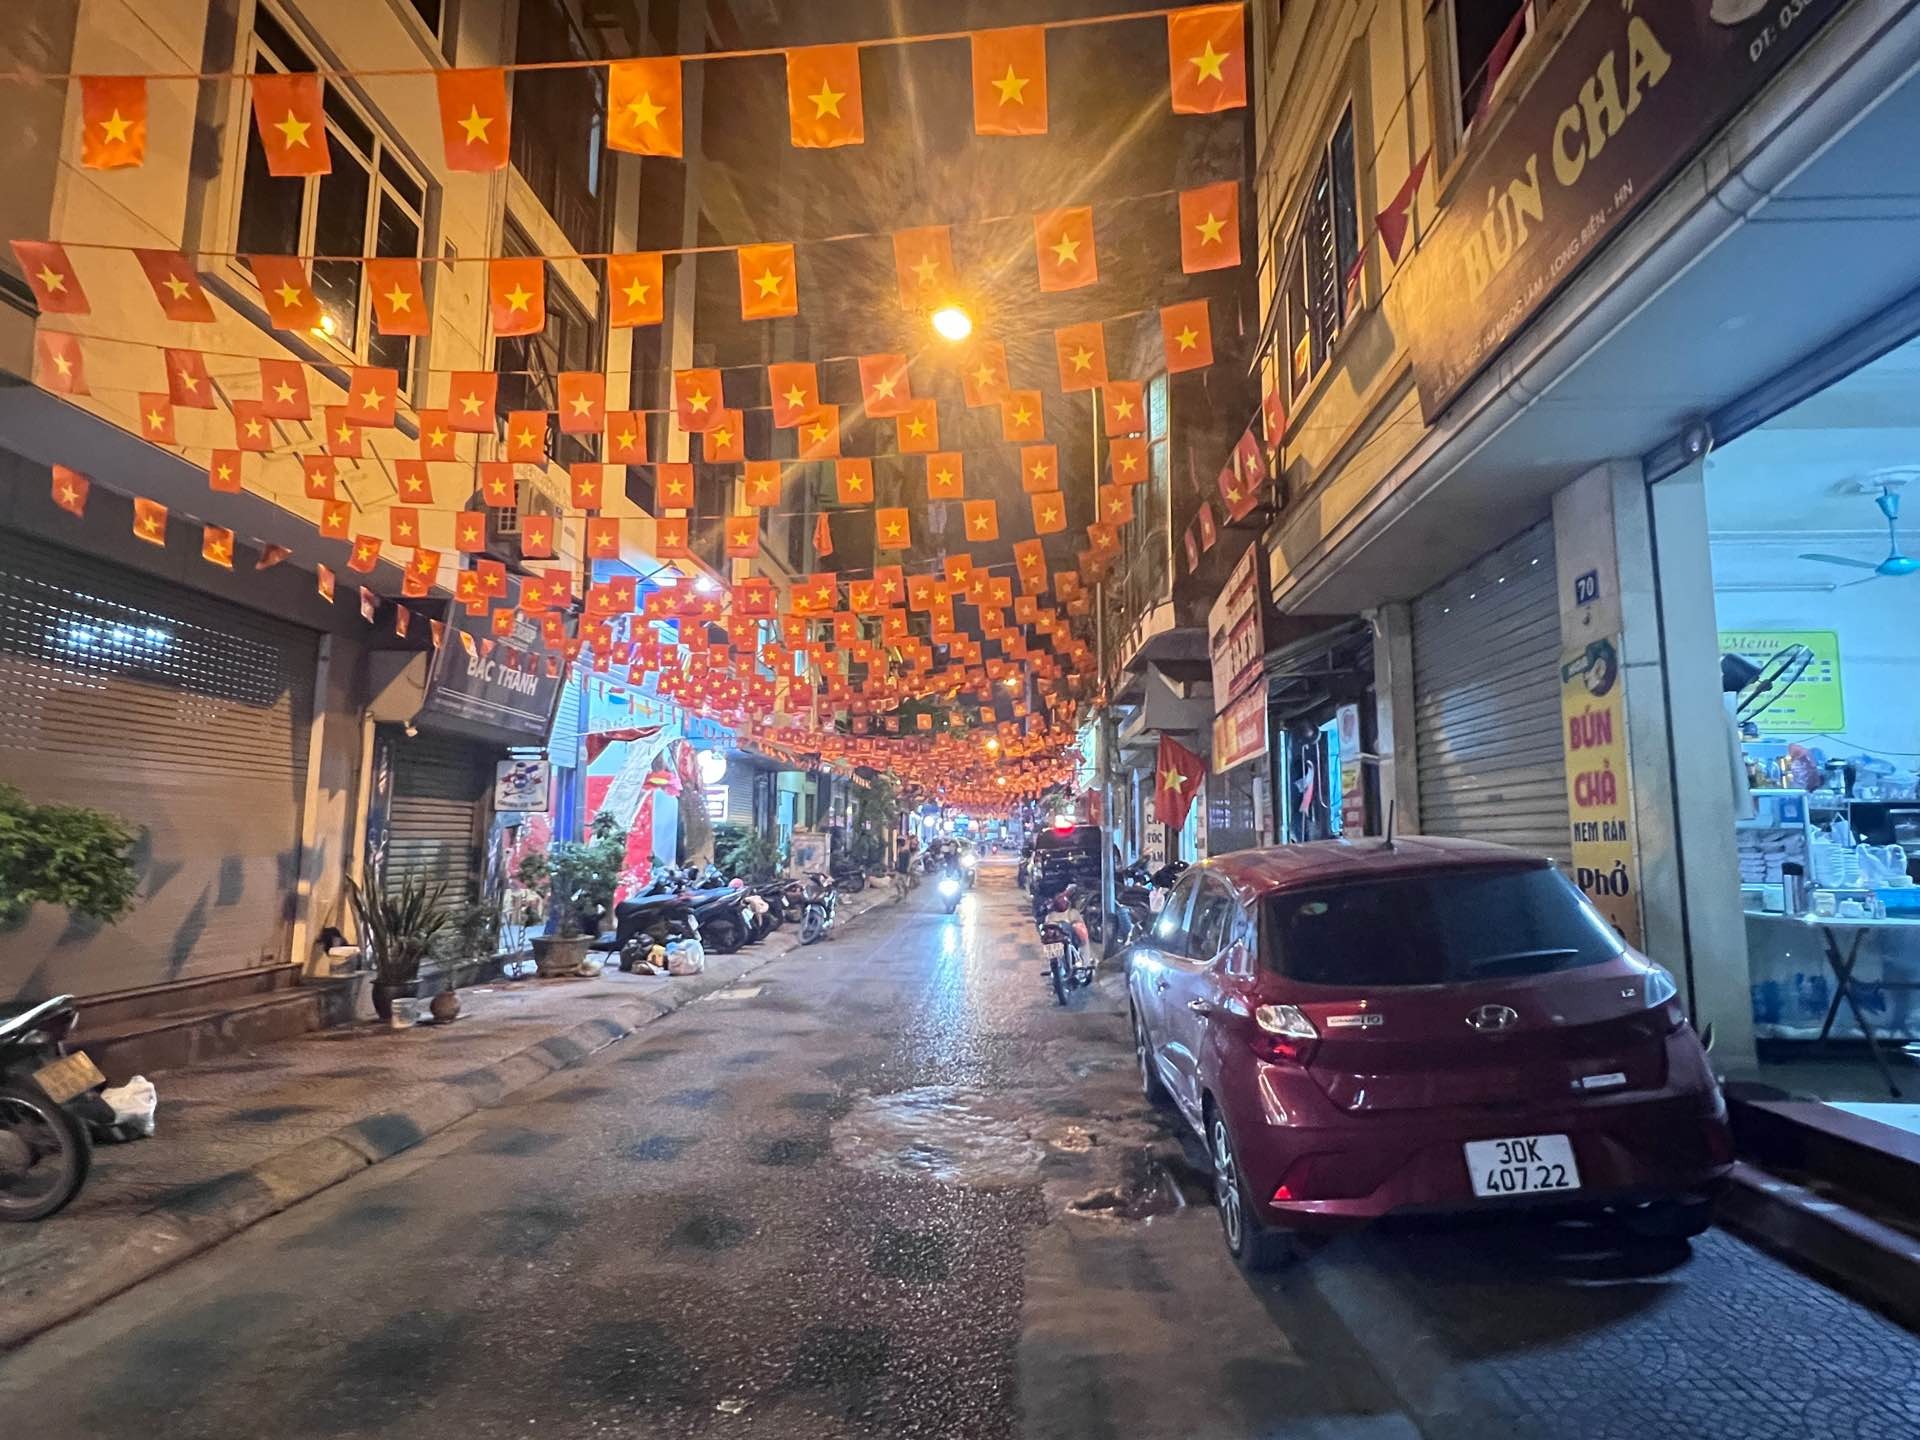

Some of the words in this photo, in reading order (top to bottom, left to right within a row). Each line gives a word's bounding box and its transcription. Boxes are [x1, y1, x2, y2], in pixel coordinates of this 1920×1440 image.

[1462, 153, 1543, 303] BÚN
[1578, 576, 1594, 601] 70
[1569, 704, 1612, 752] BÚN
[1574, 757, 1617, 807] CHẢ
[1574, 821, 1599, 842] NEM
[1495, 1138, 1542, 1165] 30K
[1486, 1164, 1569, 1192] 407.22
